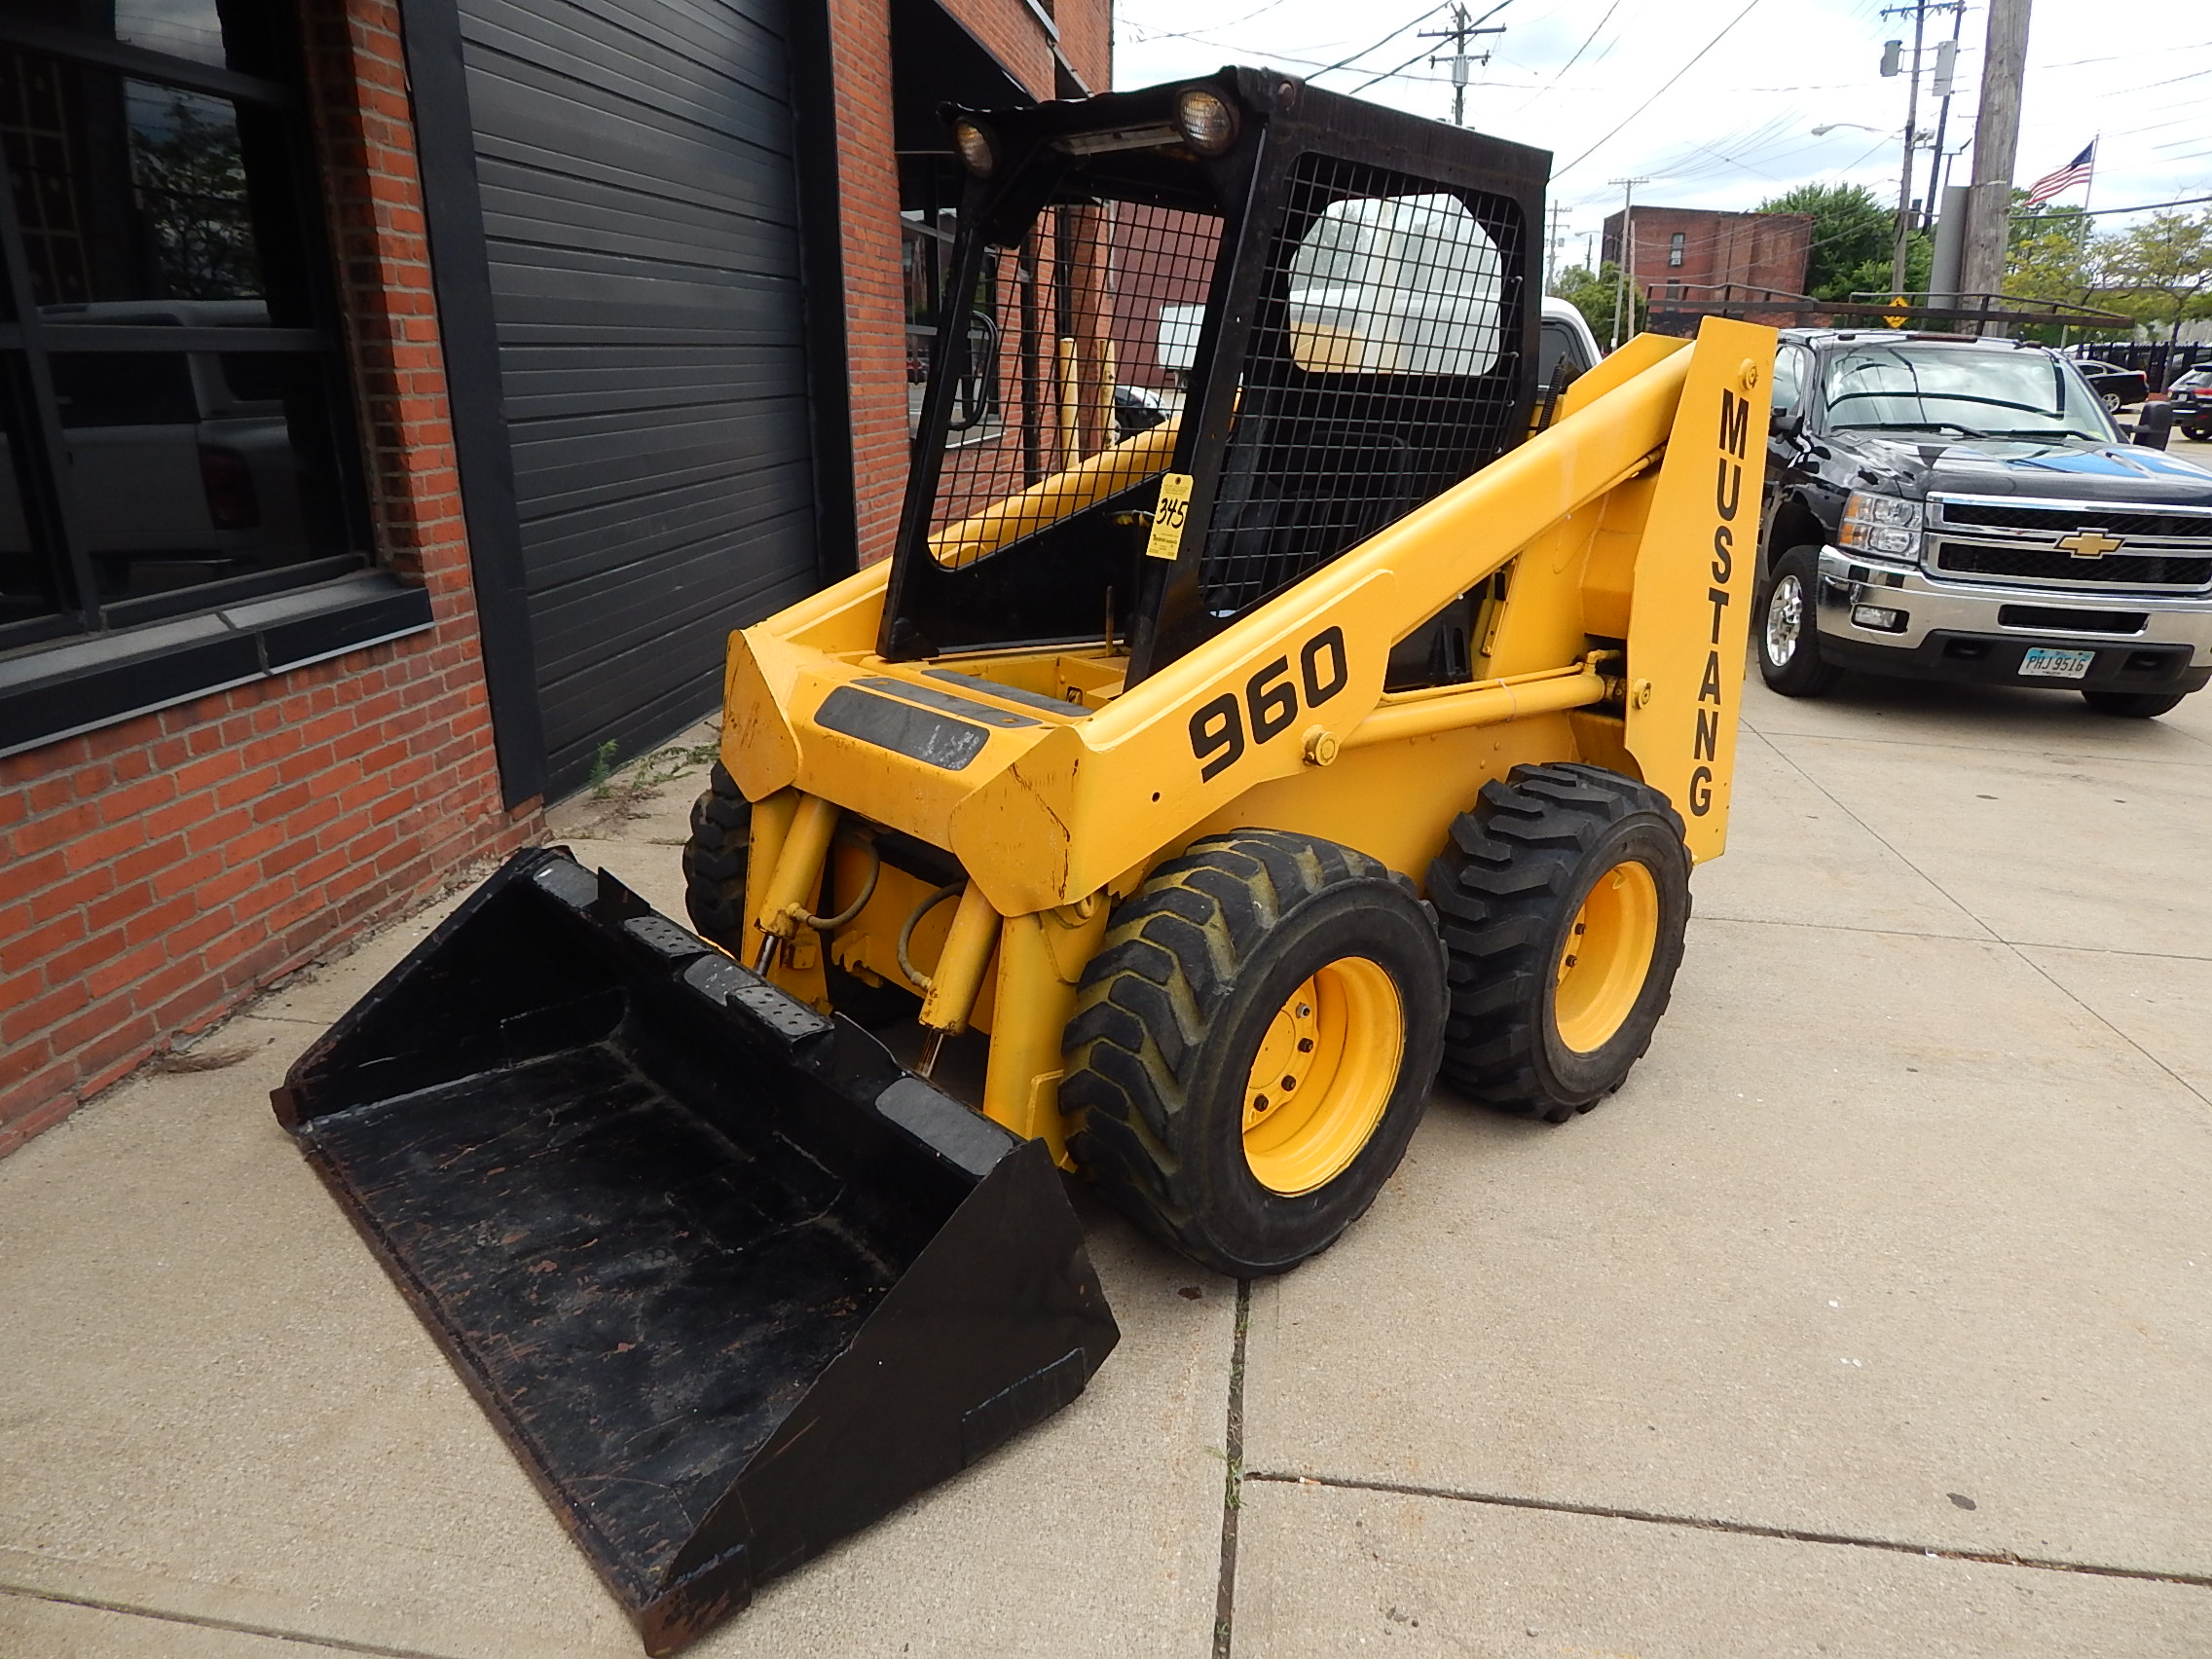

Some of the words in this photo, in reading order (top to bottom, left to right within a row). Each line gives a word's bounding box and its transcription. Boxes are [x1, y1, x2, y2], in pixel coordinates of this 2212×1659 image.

[1157, 498, 1189, 529] 345
[1689, 388, 1750, 817] MUSTANG
[1189, 625, 1348, 784] 960
[2026, 655, 2052, 670] PHJ
[2052, 657, 2086, 672] 9516
